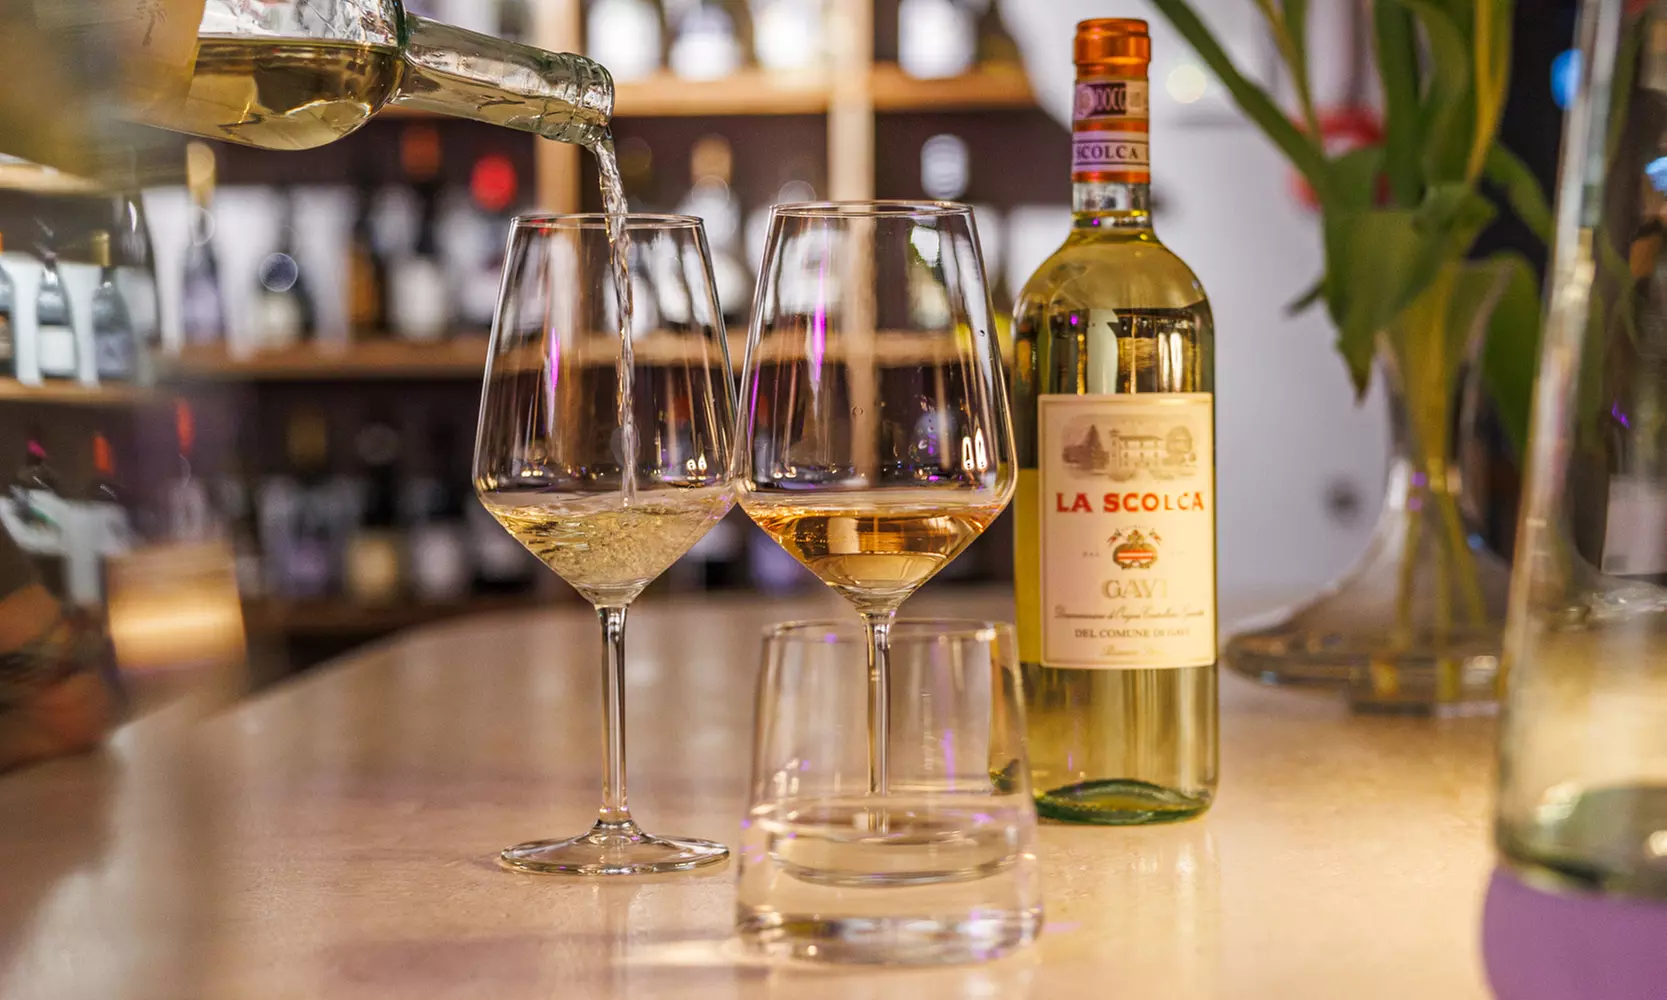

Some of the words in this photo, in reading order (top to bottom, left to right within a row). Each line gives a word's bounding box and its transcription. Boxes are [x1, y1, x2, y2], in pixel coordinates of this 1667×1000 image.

[1056, 492, 1093, 513] LA
[1103, 492, 1205, 513] SCOLCA
[1101, 578, 1168, 599] GAVI
[1075, 629, 1097, 638] DEL
[1099, 628, 1151, 638] COMUNE
